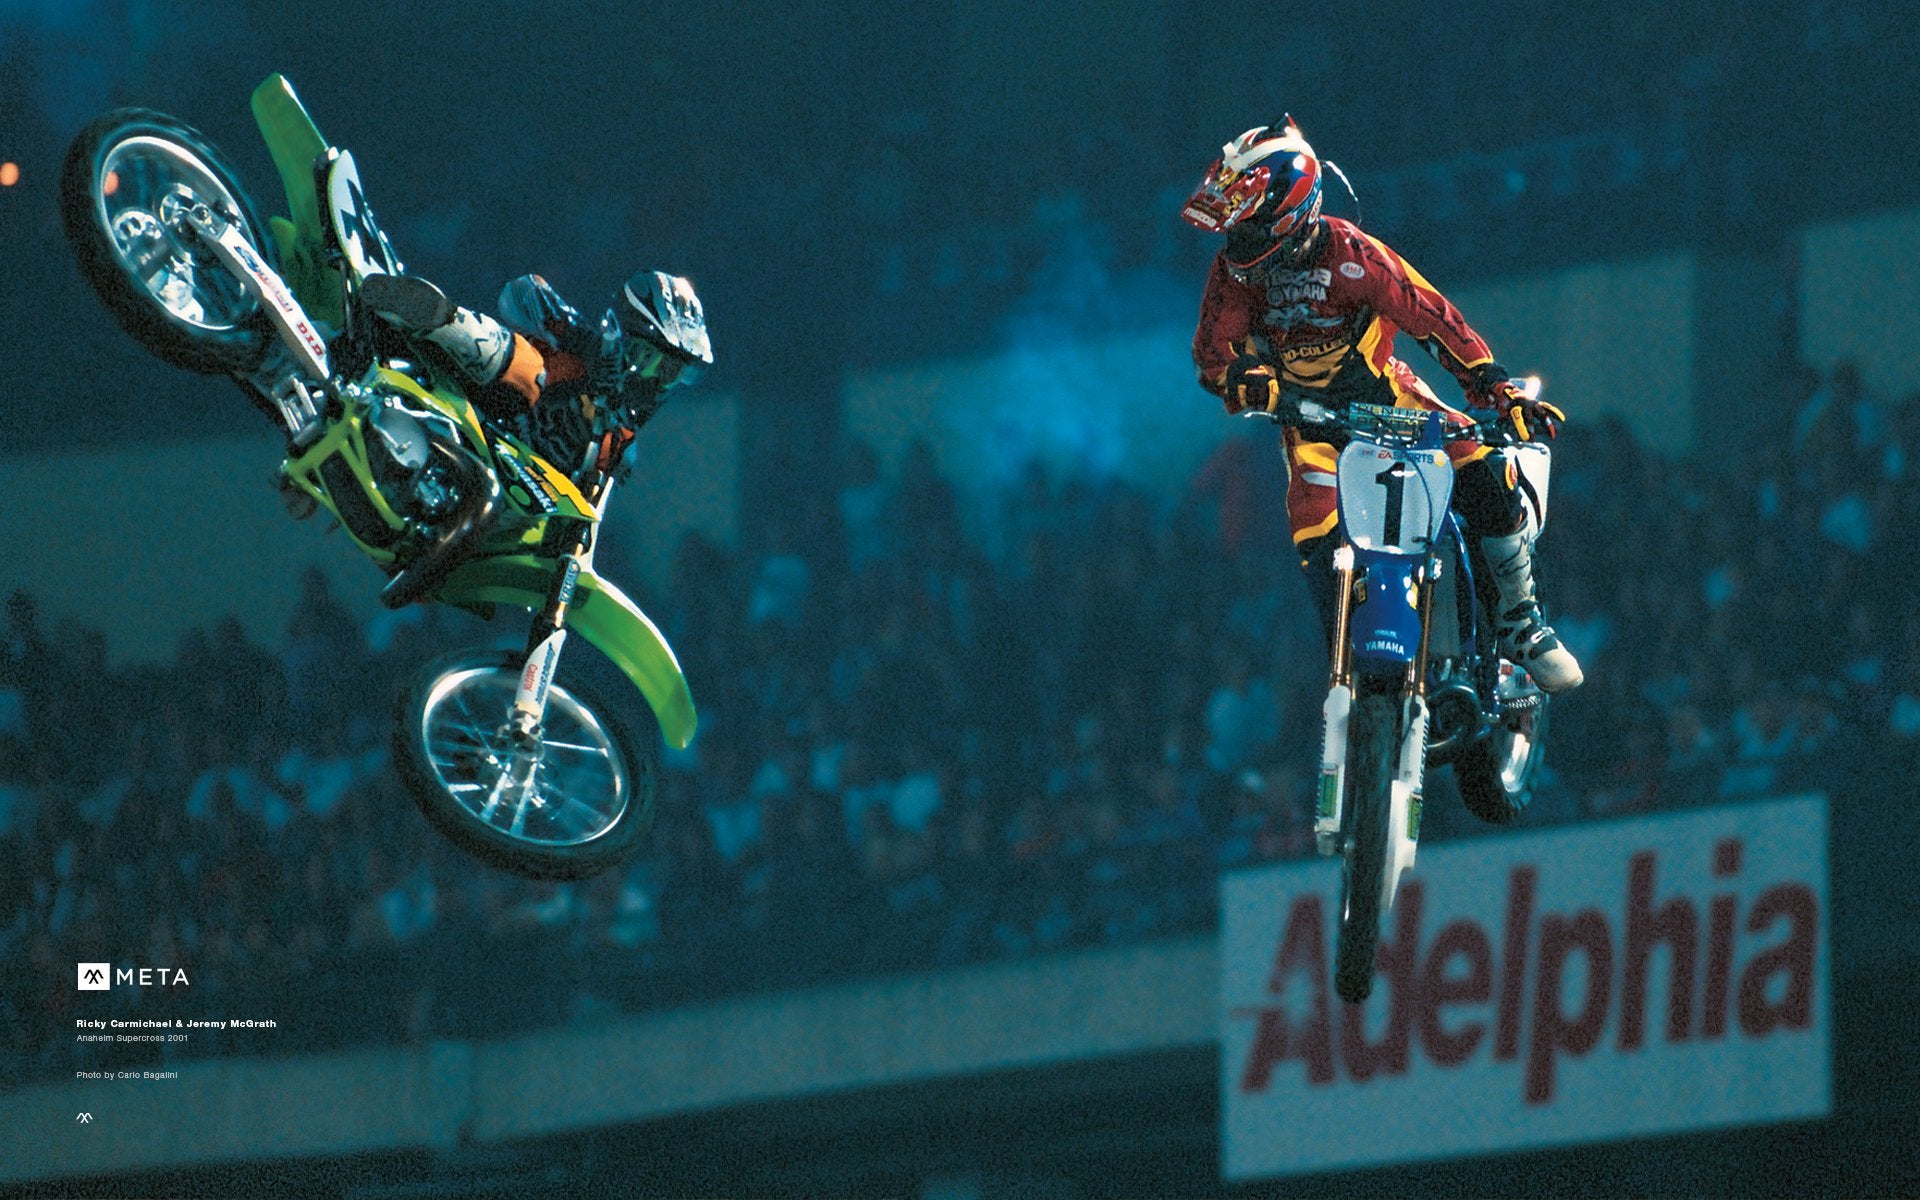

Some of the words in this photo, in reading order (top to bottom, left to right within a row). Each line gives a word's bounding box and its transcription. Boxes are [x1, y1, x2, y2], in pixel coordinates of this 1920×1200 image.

[1375, 462, 1405, 546] 1
[1365, 641, 1405, 656] YAMAHA
[1240, 837, 1819, 1106] Adelphia
